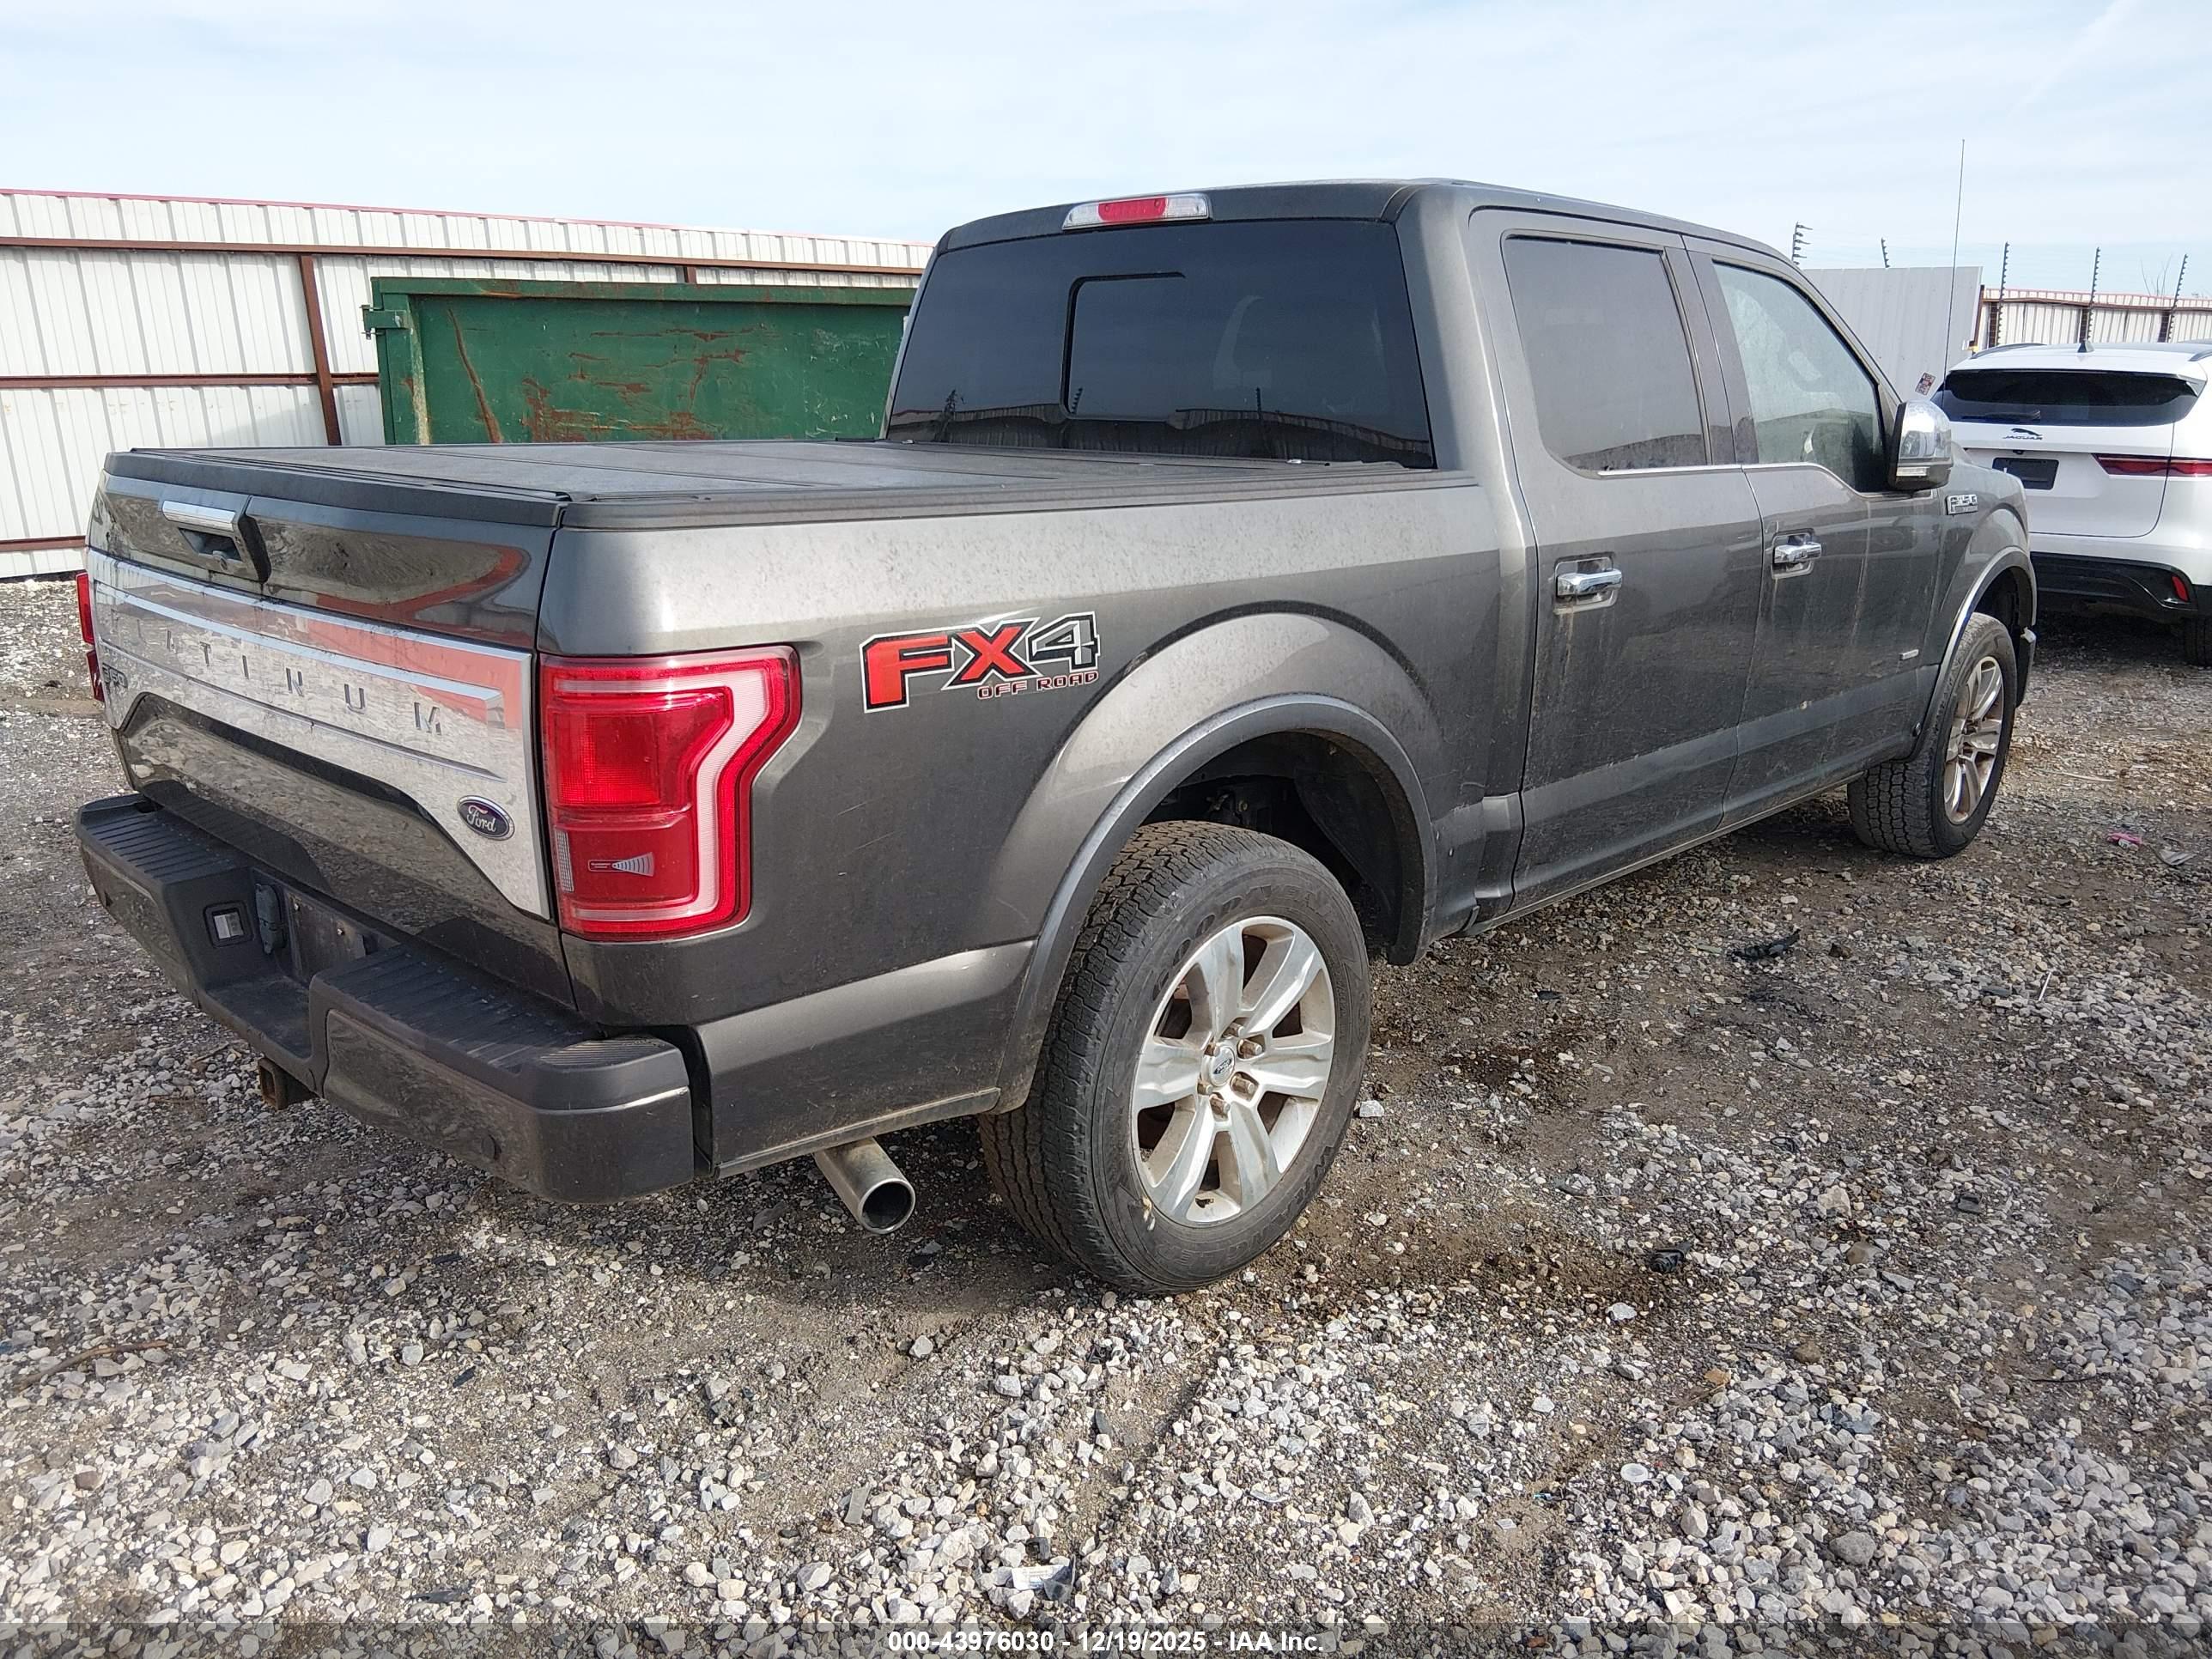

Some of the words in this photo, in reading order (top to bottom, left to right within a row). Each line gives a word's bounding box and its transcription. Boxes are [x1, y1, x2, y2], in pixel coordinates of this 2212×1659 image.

[859, 611, 1100, 714] FX4
[977, 681, 1027, 700] OFF
[1036, 671, 1099, 692] ROAD
[466, 805, 497, 833] Ford
